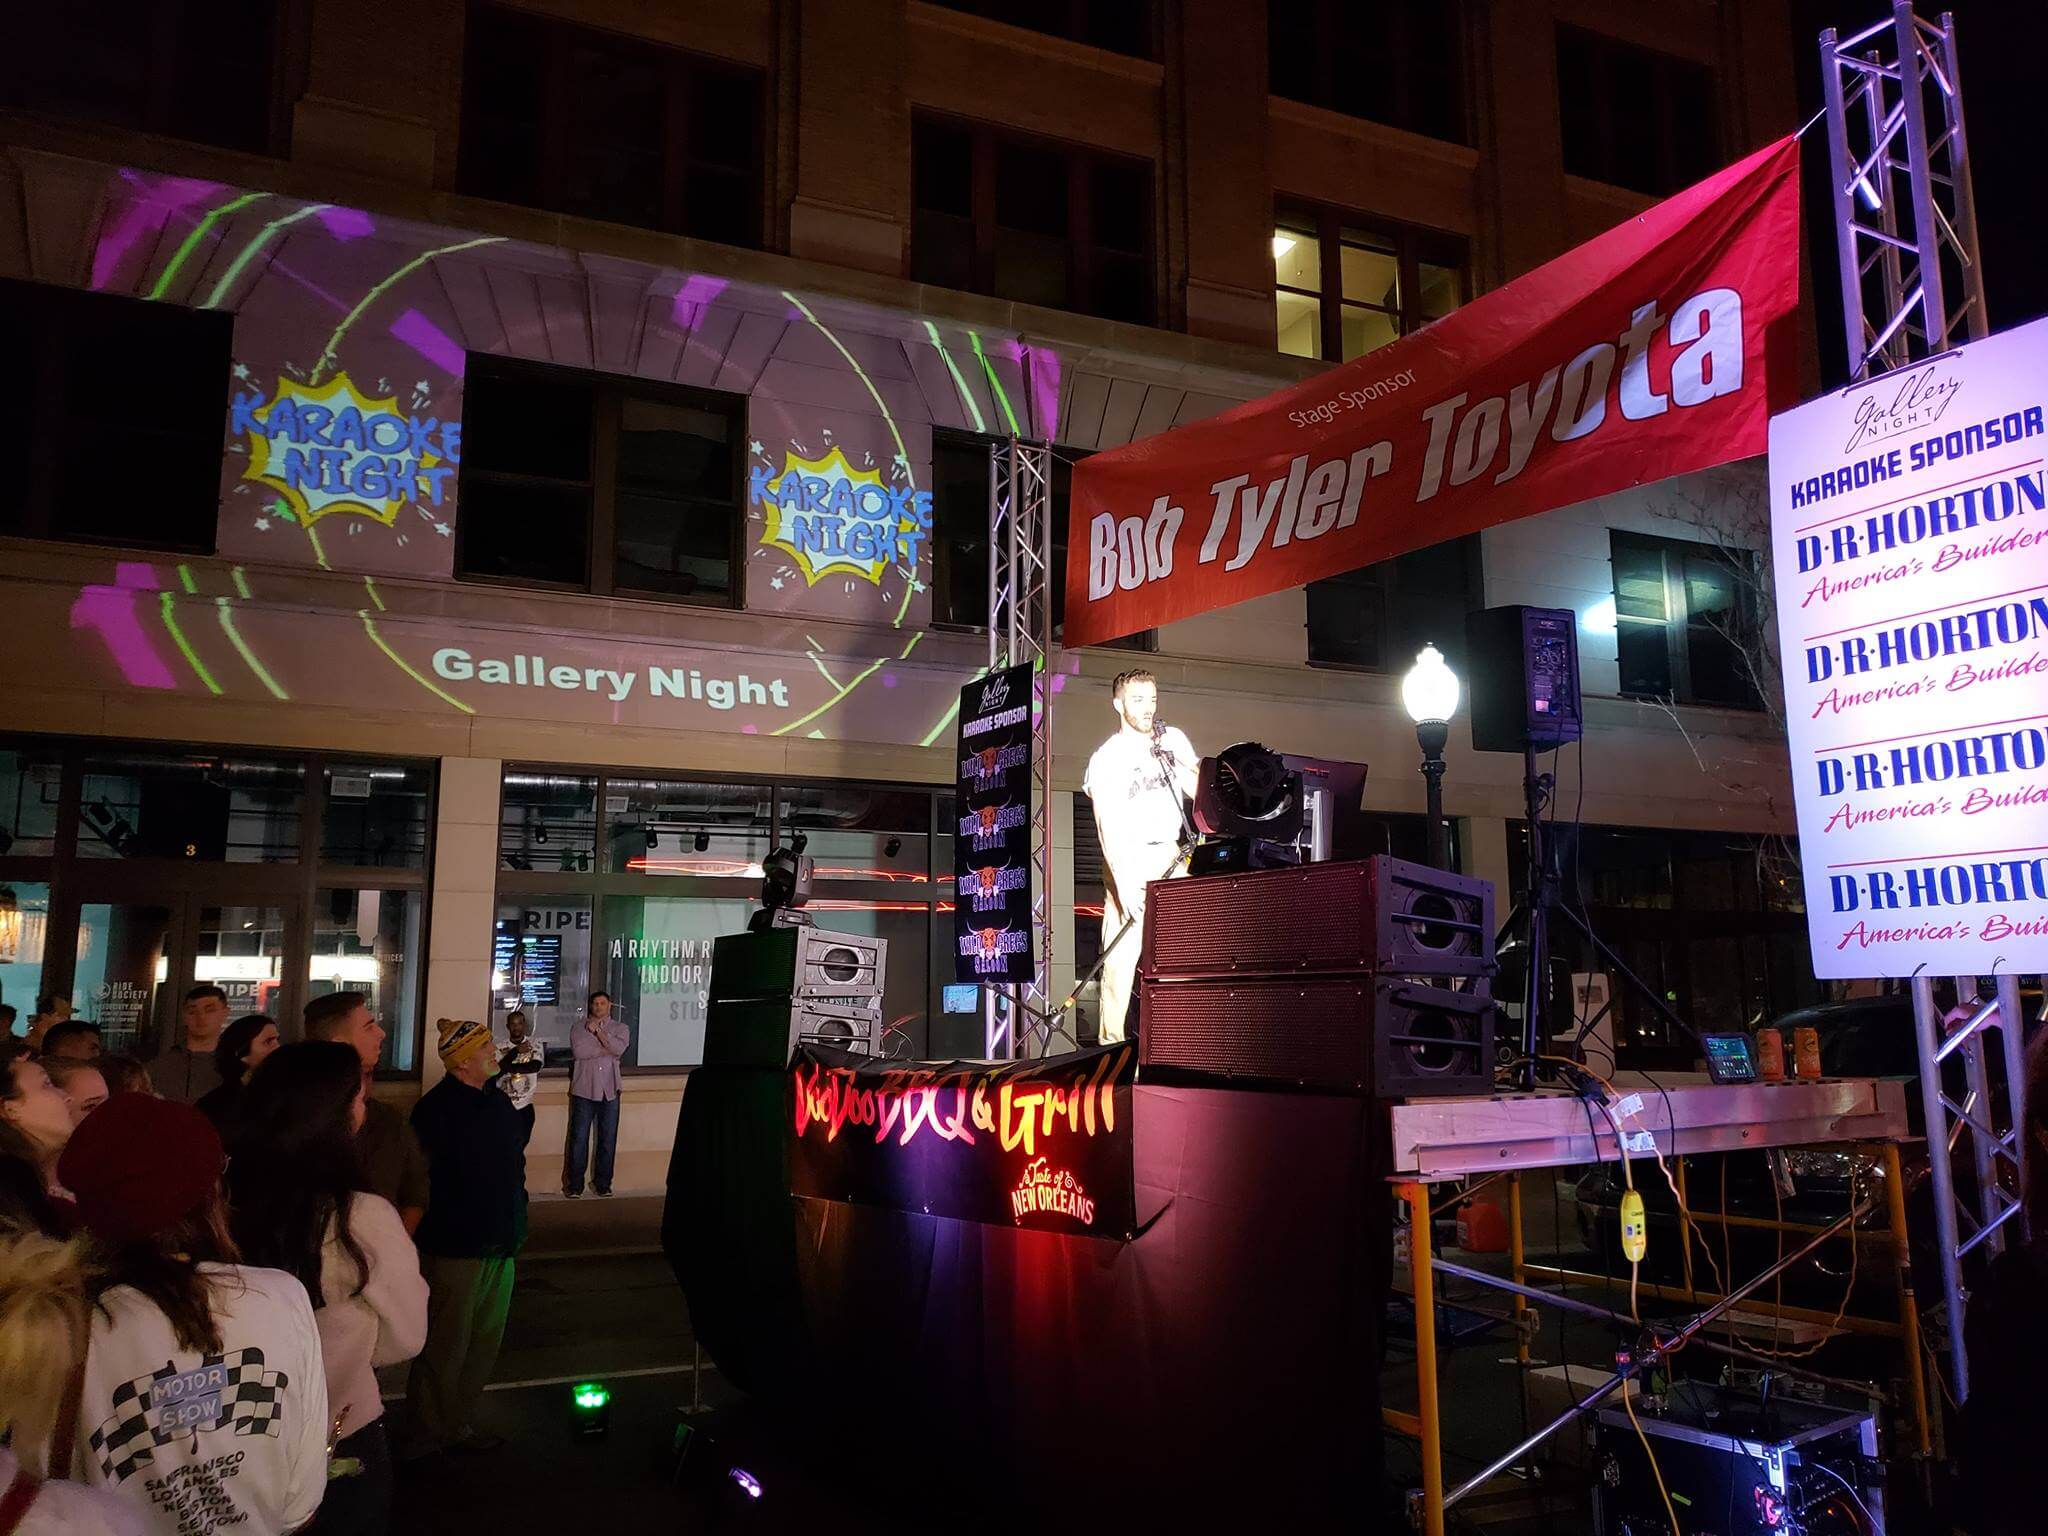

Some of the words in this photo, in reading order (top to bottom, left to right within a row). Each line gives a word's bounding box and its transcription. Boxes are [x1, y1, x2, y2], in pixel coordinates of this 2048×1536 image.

[1288, 399, 1340, 429] Stage
[1341, 367, 1417, 411] Sponsor
[1845, 366, 1966, 454] Gallery
[231, 391, 461, 464] KARAOKE
[1868, 407, 1934, 437] NIGHT
[1088, 495, 1185, 602] Bob
[1198, 439, 1393, 573] Tyler
[1415, 287, 1745, 503] Toyota
[1791, 449, 1902, 509] KARAOKE
[1910, 405, 2045, 472] SPONSOR
[284, 447, 454, 506] NIGHT
[750, 465, 933, 529] KARAOKE
[793, 515, 926, 567] NIGHT
[1801, 558, 1923, 609] America's
[432, 648, 636, 701] Gallery
[648, 666, 789, 710] Night
[1811, 676, 1937, 719] America's
[963, 715, 993, 739] KARAOKE
[994, 705, 1027, 730] SPONSOR
[1823, 796, 1952, 833] America's
[186, 844, 196, 856] 3
[523, 910, 591, 930] RIPE
[1837, 921, 1969, 950] America's
[612, 939, 622, 959] A
[628, 939, 695, 959] RHYTHM
[641, 965, 702, 984] INDOOR
[874, 1069, 976, 1146] BBQ
[972, 1066, 997, 1134] &
[1000, 1046, 1132, 1156] Grill
[1028, 1157, 1052, 1187] Taste
[1054, 1170, 1064, 1194] of
[1011, 1187, 1037, 1217] NEW
[1037, 1184, 1094, 1225] ORLEANS
[153, 1369, 222, 1401] MOTOR
